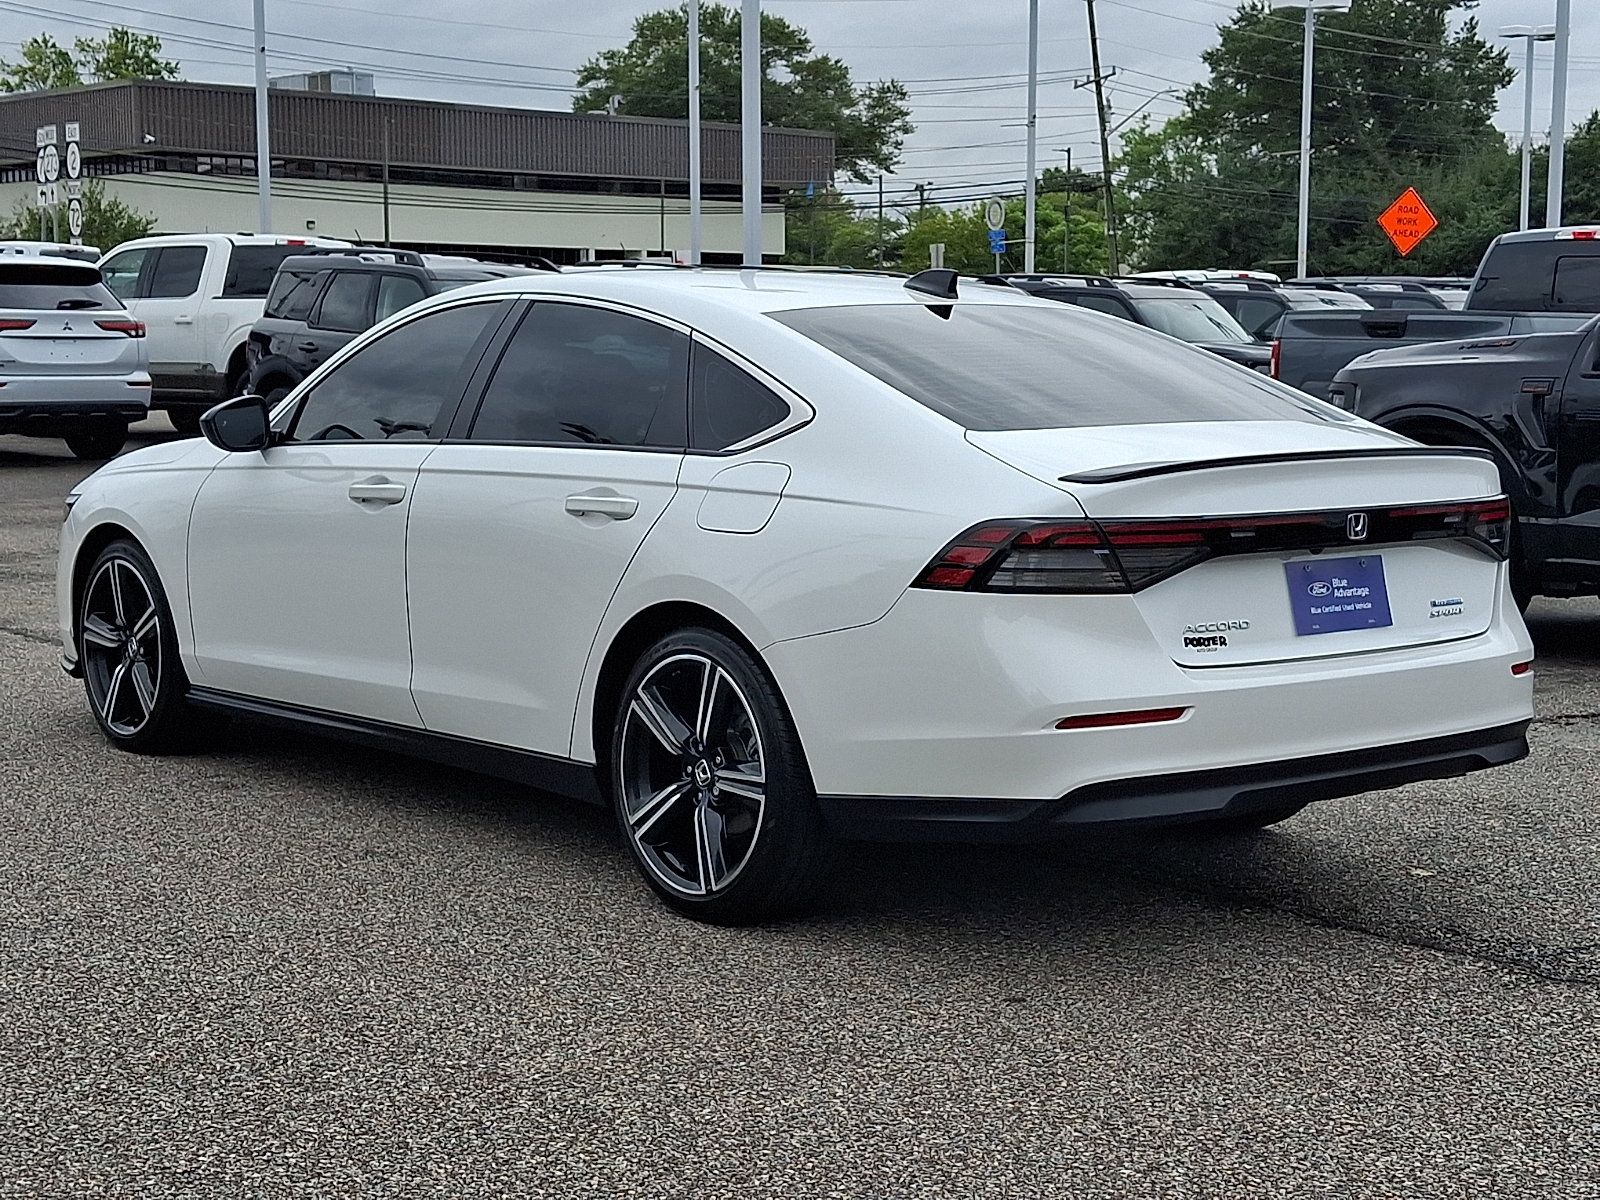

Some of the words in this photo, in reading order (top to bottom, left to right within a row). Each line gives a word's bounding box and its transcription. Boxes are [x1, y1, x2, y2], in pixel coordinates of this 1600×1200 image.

[70, 150, 77, 171] 2
[1397, 205, 1420, 215] ROAD
[71, 208, 80, 228] 72
[1396, 217, 1418, 226] WORK
[1392, 229, 1420, 238] AHEAD
[1332, 577, 1348, 588] Blue
[1333, 587, 1370, 598] Advantage
[1182, 620, 1251, 635] ACCORD
[1182, 634, 1228, 649] PORTER
